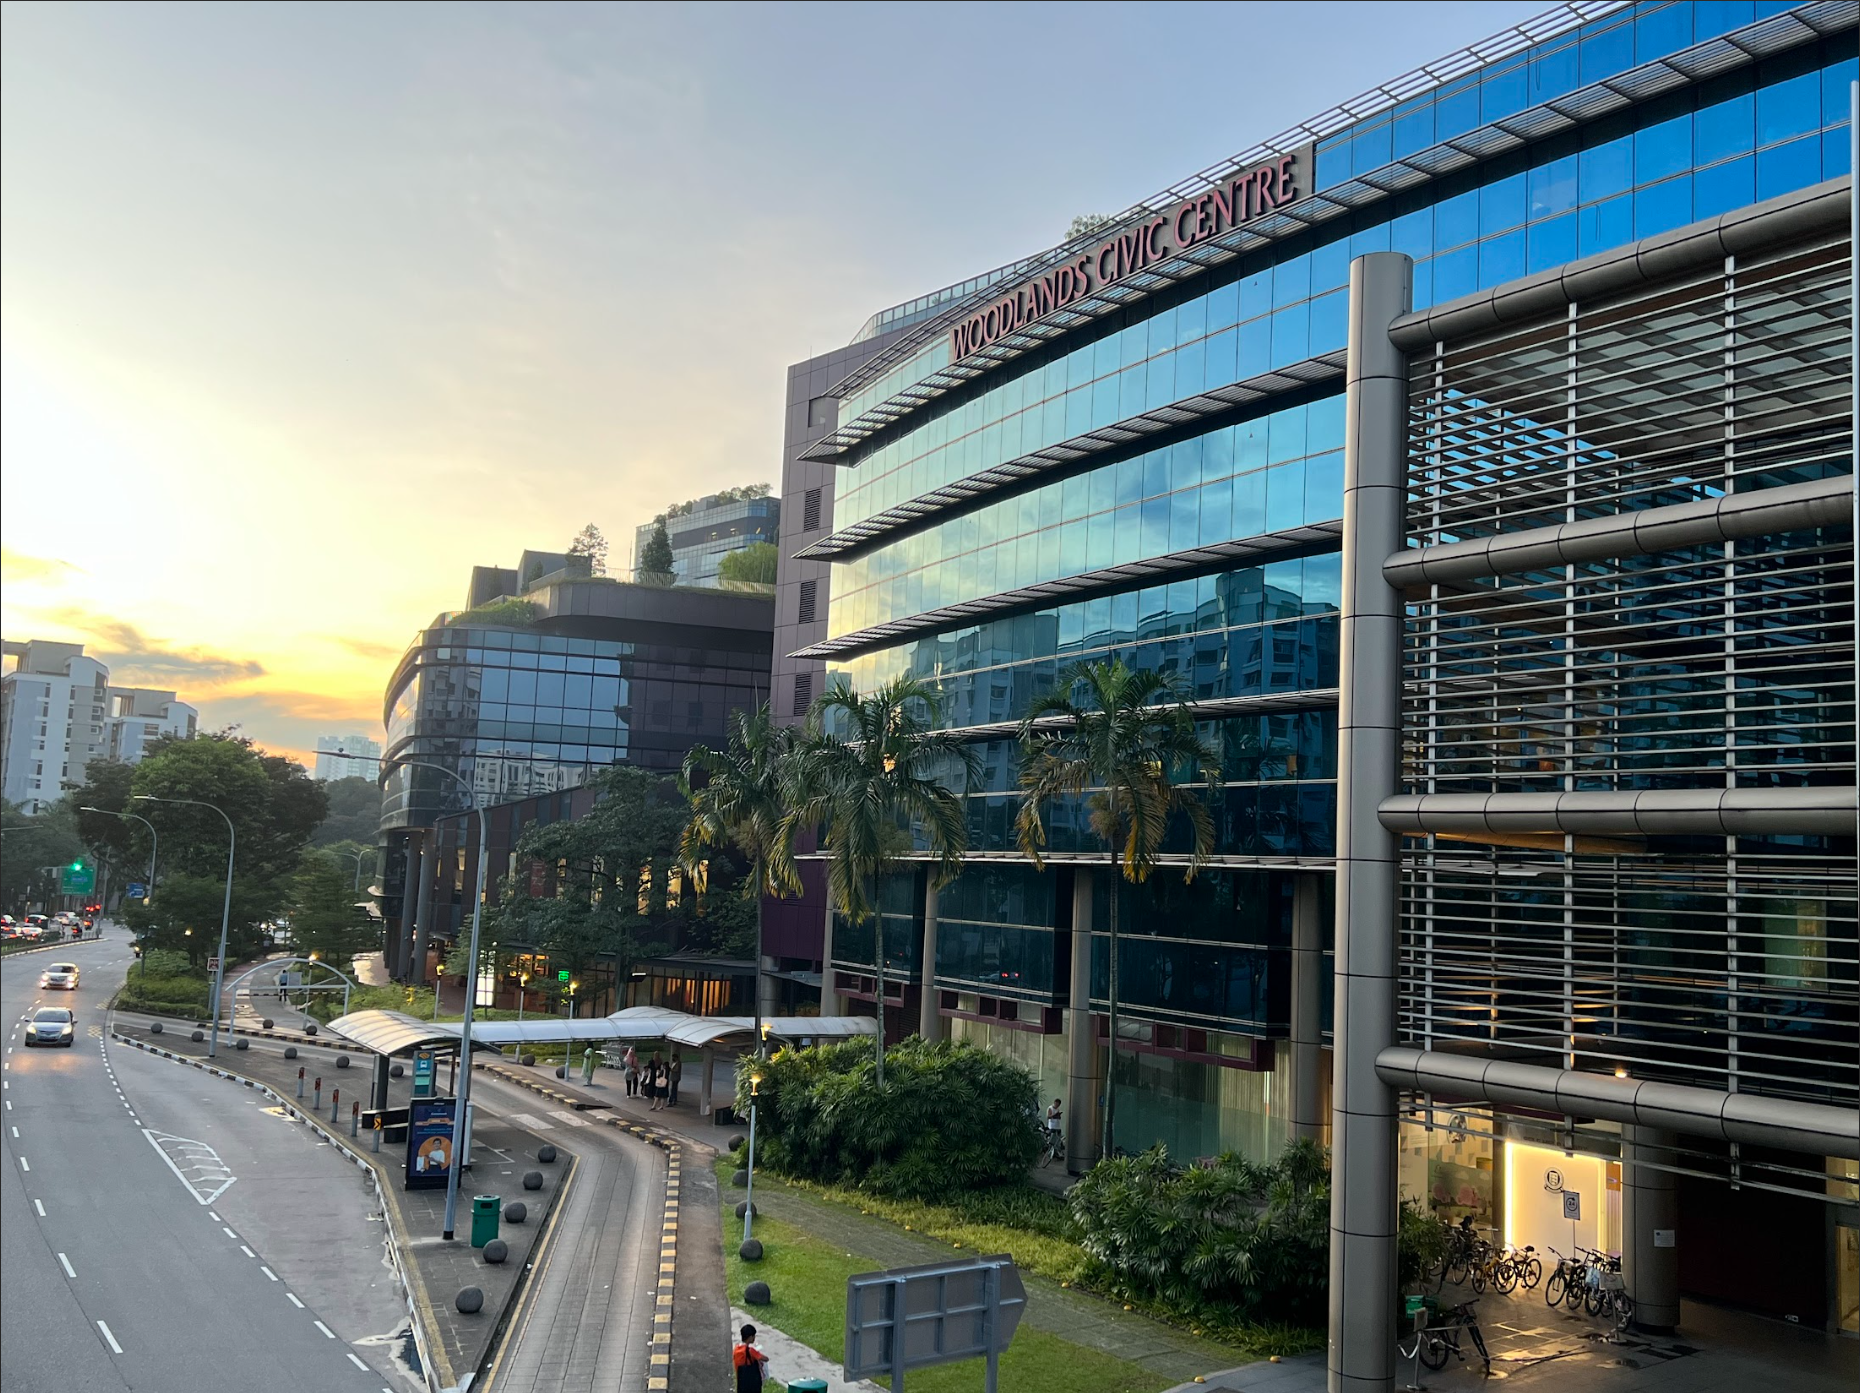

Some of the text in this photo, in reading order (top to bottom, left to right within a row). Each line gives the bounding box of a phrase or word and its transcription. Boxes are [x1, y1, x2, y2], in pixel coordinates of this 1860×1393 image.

[951, 155, 1296, 361] WOODLANDS CIVIC CENTRE
